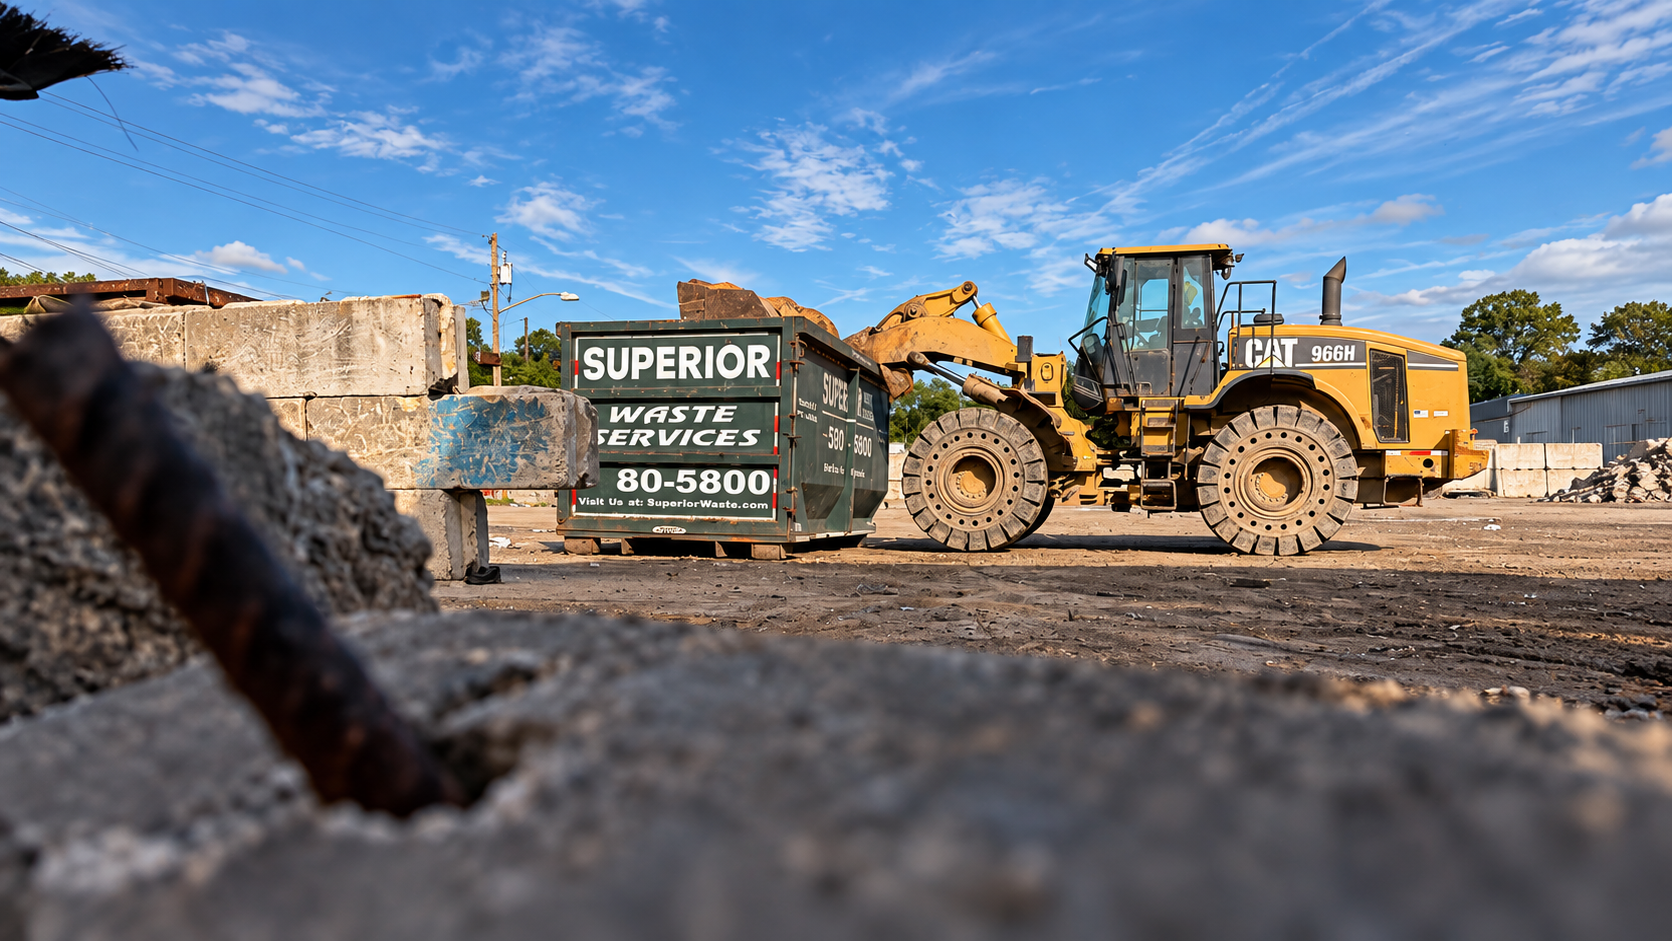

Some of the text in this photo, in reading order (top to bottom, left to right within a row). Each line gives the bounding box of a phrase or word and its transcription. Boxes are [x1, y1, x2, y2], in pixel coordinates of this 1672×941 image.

[583, 344, 771, 381] SUPERIOR
[1245, 338, 1356, 368] CAT 966H
[609, 406, 737, 425] WASTE
[616, 468, 770, 495] 80-5800
[578, 497, 768, 509] Visit Us at: SuperiorWaste.com
